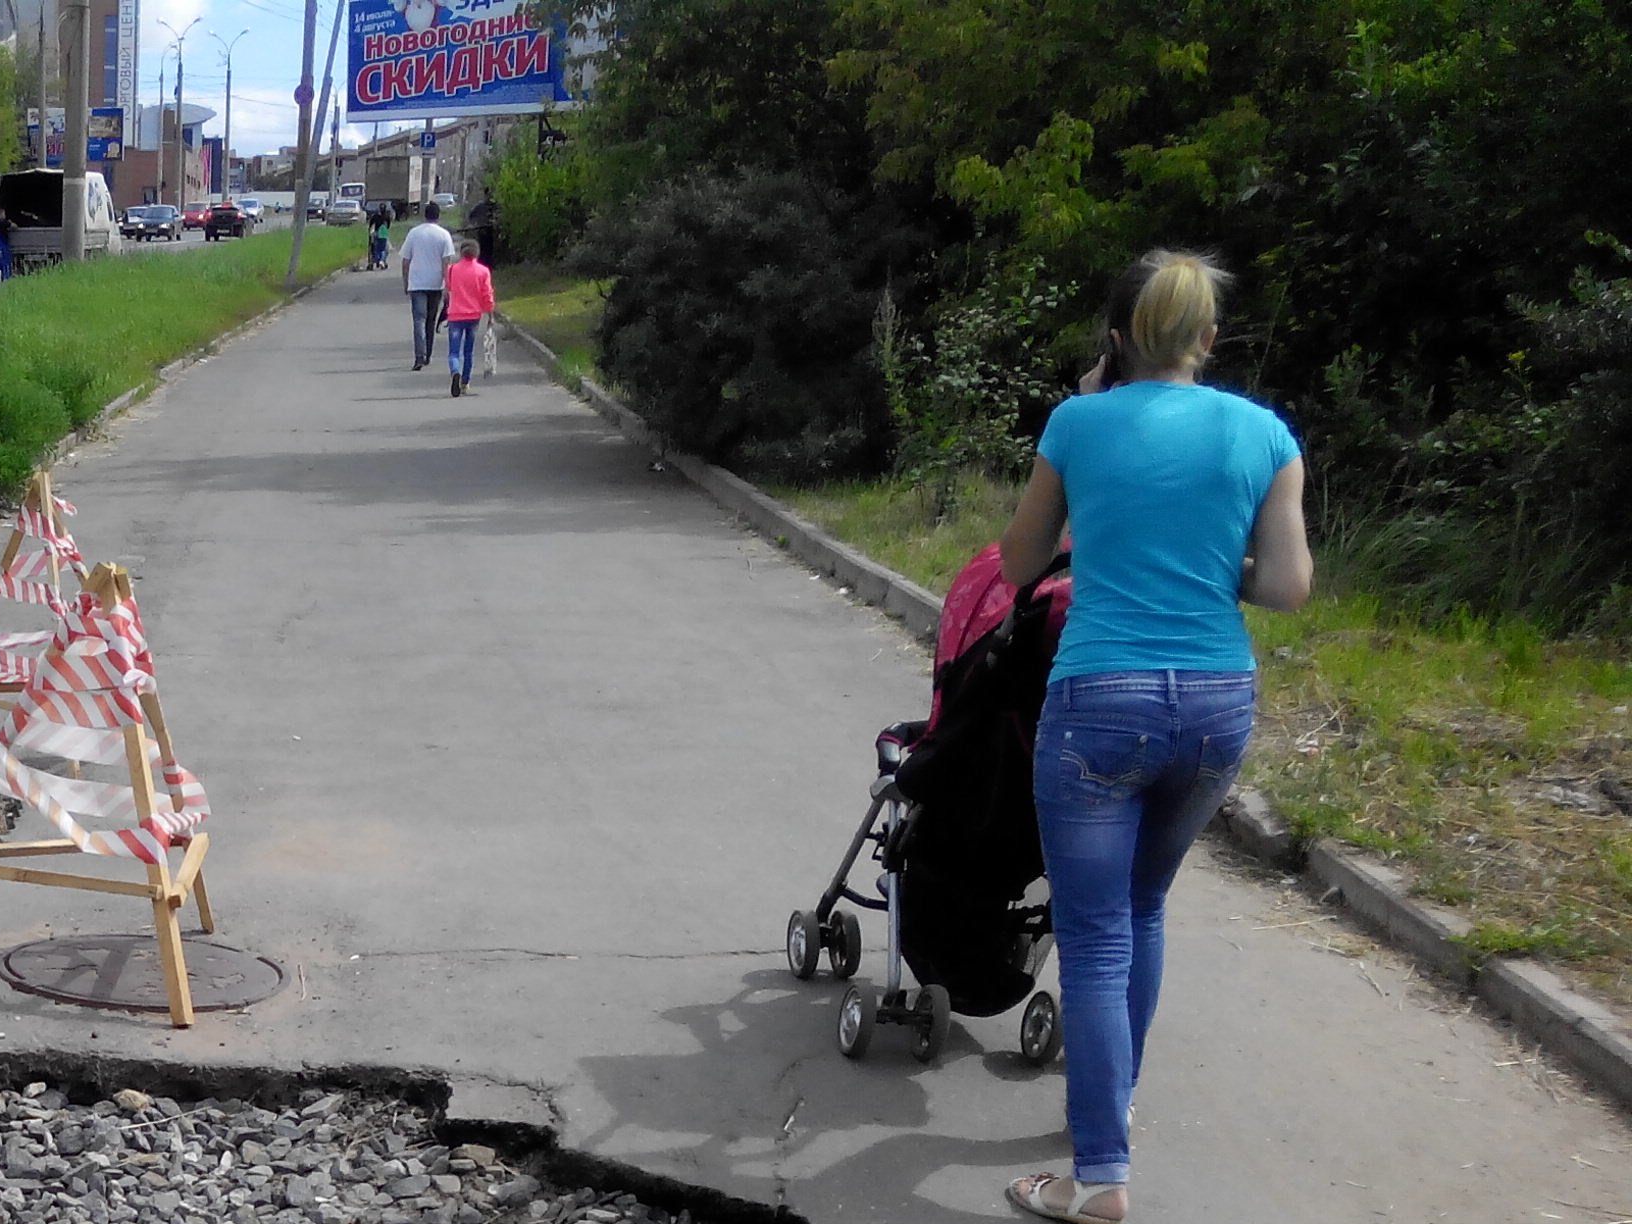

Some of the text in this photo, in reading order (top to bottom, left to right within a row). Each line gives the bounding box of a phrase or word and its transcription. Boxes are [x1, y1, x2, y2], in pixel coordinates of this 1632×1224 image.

[355, 11, 365, 23] 14
[119, 0, 133, 120] ОРГОВЫЙ ЦЕН
[356, 31, 549, 105] СКИДКИ
